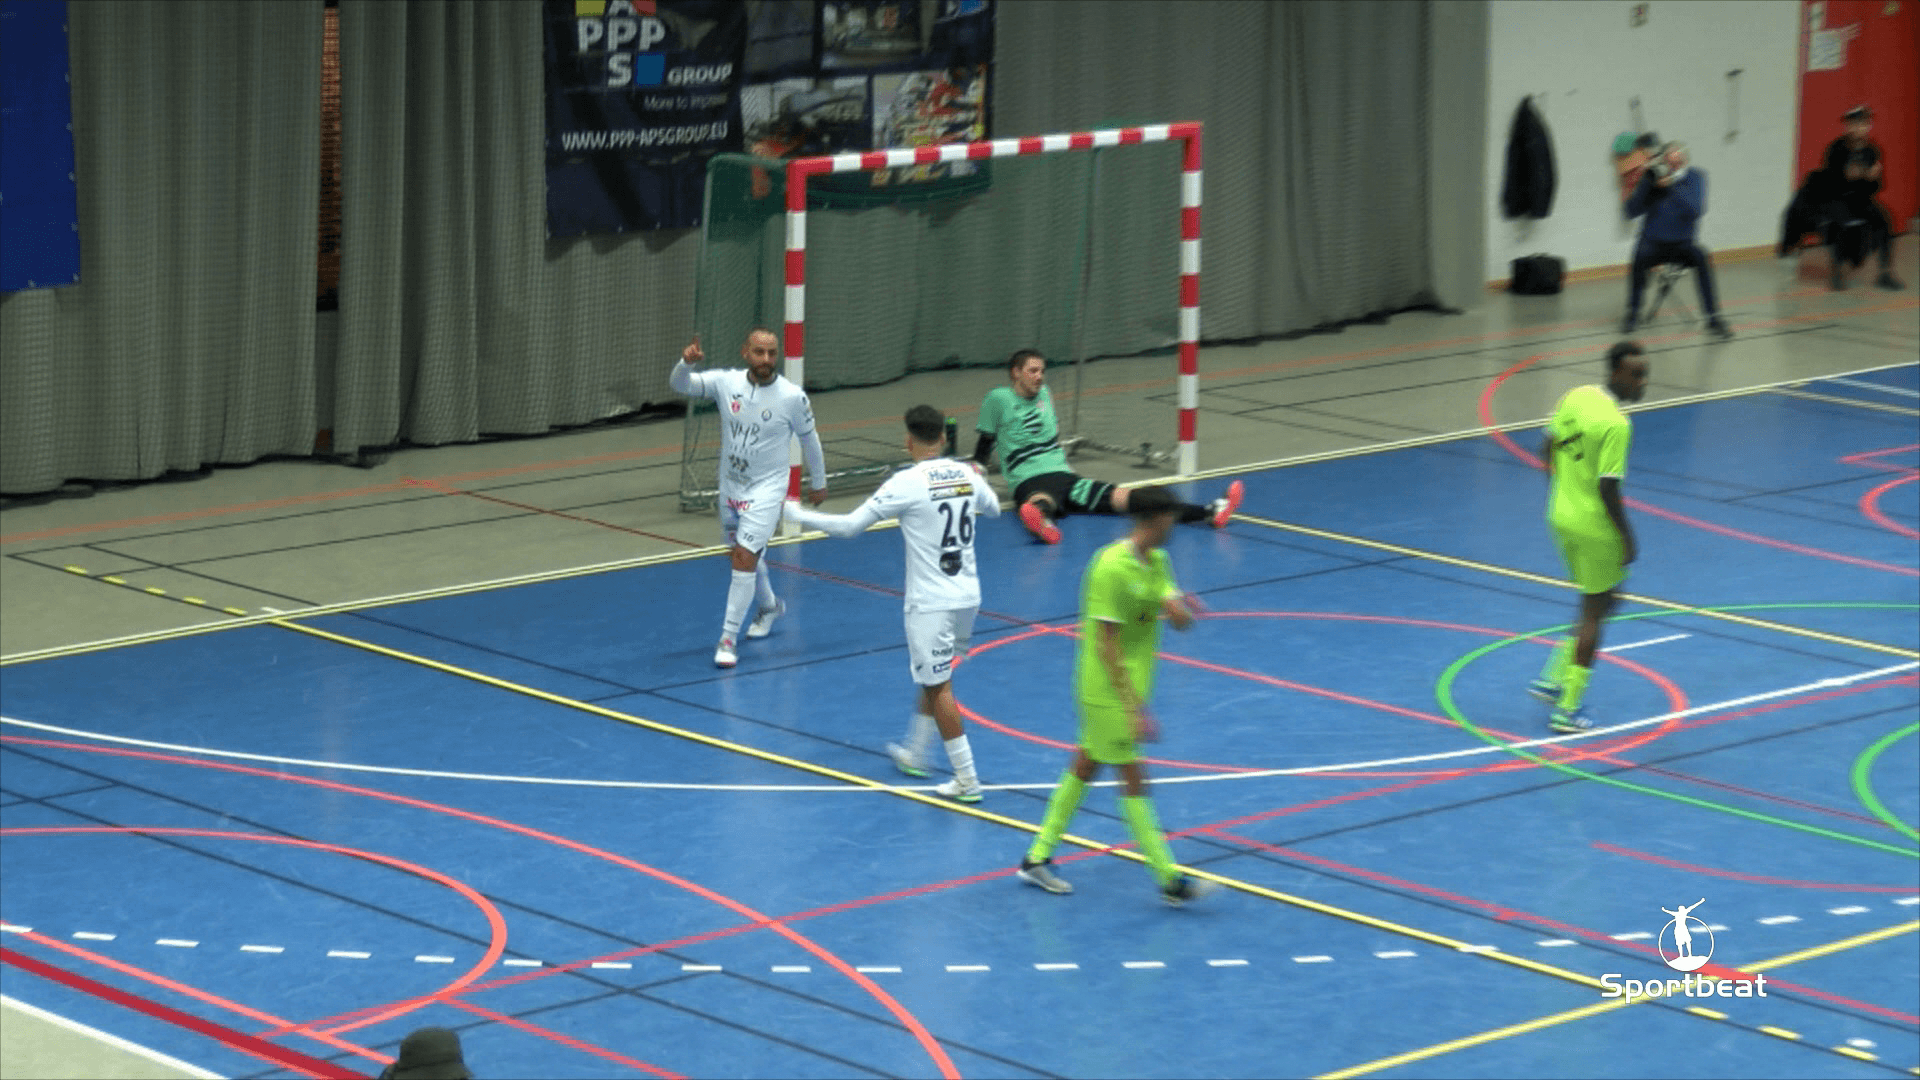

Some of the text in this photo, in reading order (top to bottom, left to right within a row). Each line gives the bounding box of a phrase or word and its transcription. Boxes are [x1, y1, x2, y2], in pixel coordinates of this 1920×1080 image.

[577, 18, 666, 52] PPP
[667, 62, 733, 86] GROUP
[938, 500, 972, 547] 26
